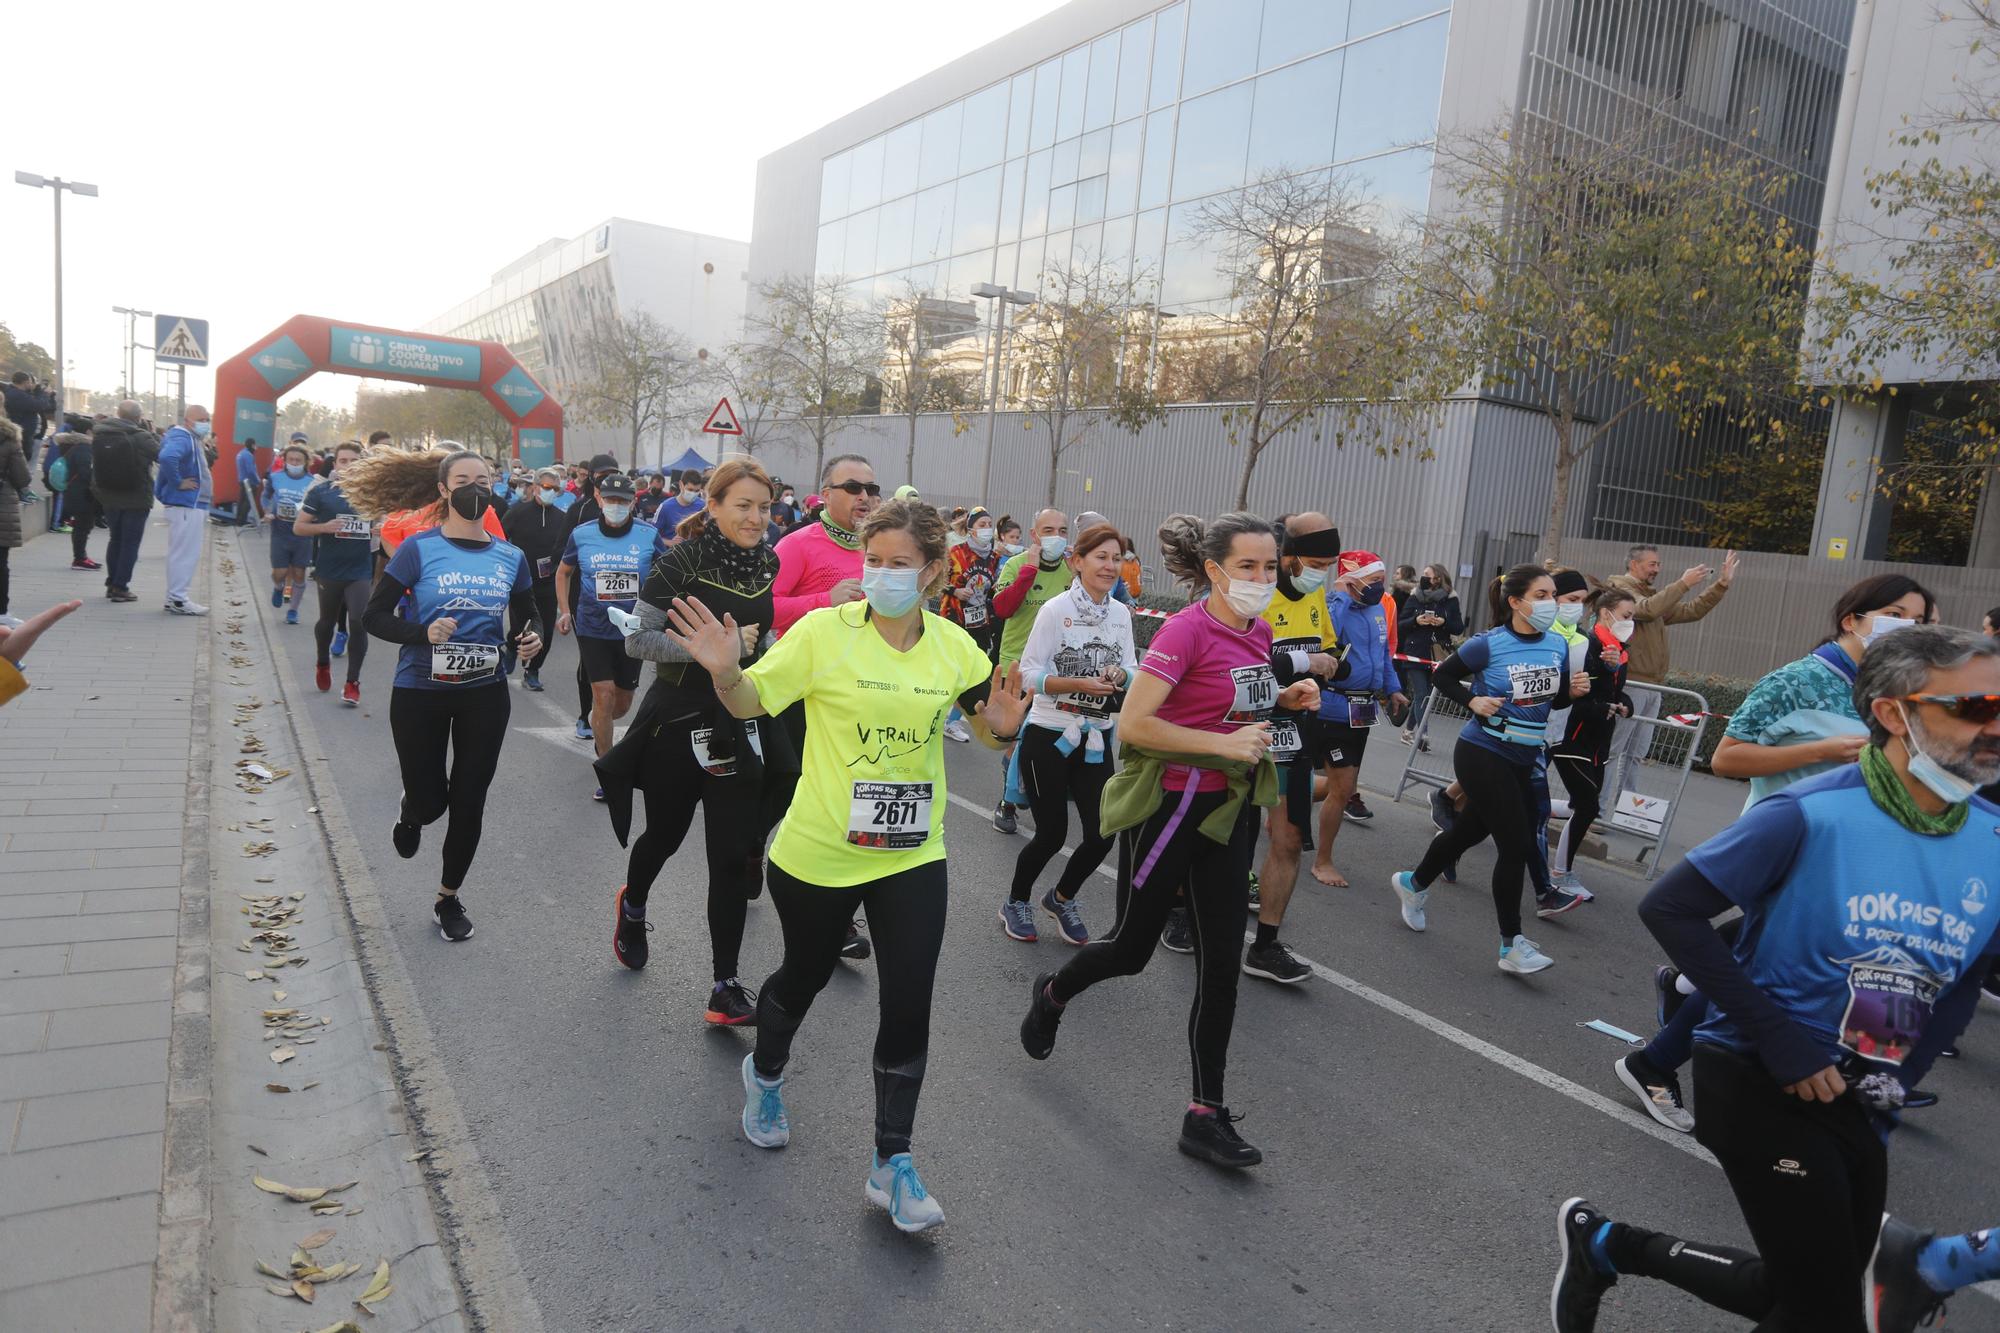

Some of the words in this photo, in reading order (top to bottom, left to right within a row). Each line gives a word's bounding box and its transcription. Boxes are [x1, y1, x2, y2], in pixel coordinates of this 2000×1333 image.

[388, 341, 426, 352] GRUPO
[388, 350, 464, 366] COOPERATIVO
[388, 360, 439, 371] CAJAMAR
[345, 522, 363, 530] 2714
[590, 553, 606, 563] 10K
[438, 572, 462, 587] 10K
[463, 576, 486, 584] PAS
[489, 578, 507, 591] RAS
[605, 580, 630, 590] 2261
[446, 655, 485, 670] 2245
[857, 680, 891, 691] TRIFITNESS
[1248, 681, 1271, 704] 1041
[1523, 678, 1551, 694] 2238
[857, 723, 870, 744] V
[1268, 732, 1294, 746] 809
[856, 784, 870, 793] 10K
[885, 786, 898, 795] RAS
[872, 801, 917, 825] 2671
[1846, 892, 1898, 922] 10K
[1899, 901, 1942, 926] PAS
[1943, 913, 1975, 944] RAS
[1844, 924, 1860, 937] AL
[1865, 927, 1904, 944] PORT
[1906, 935, 1922, 948] DE
[1854, 968, 1873, 981] 10K
[1873, 972, 1894, 982] PAS
[1896, 976, 1914, 989] RAS
